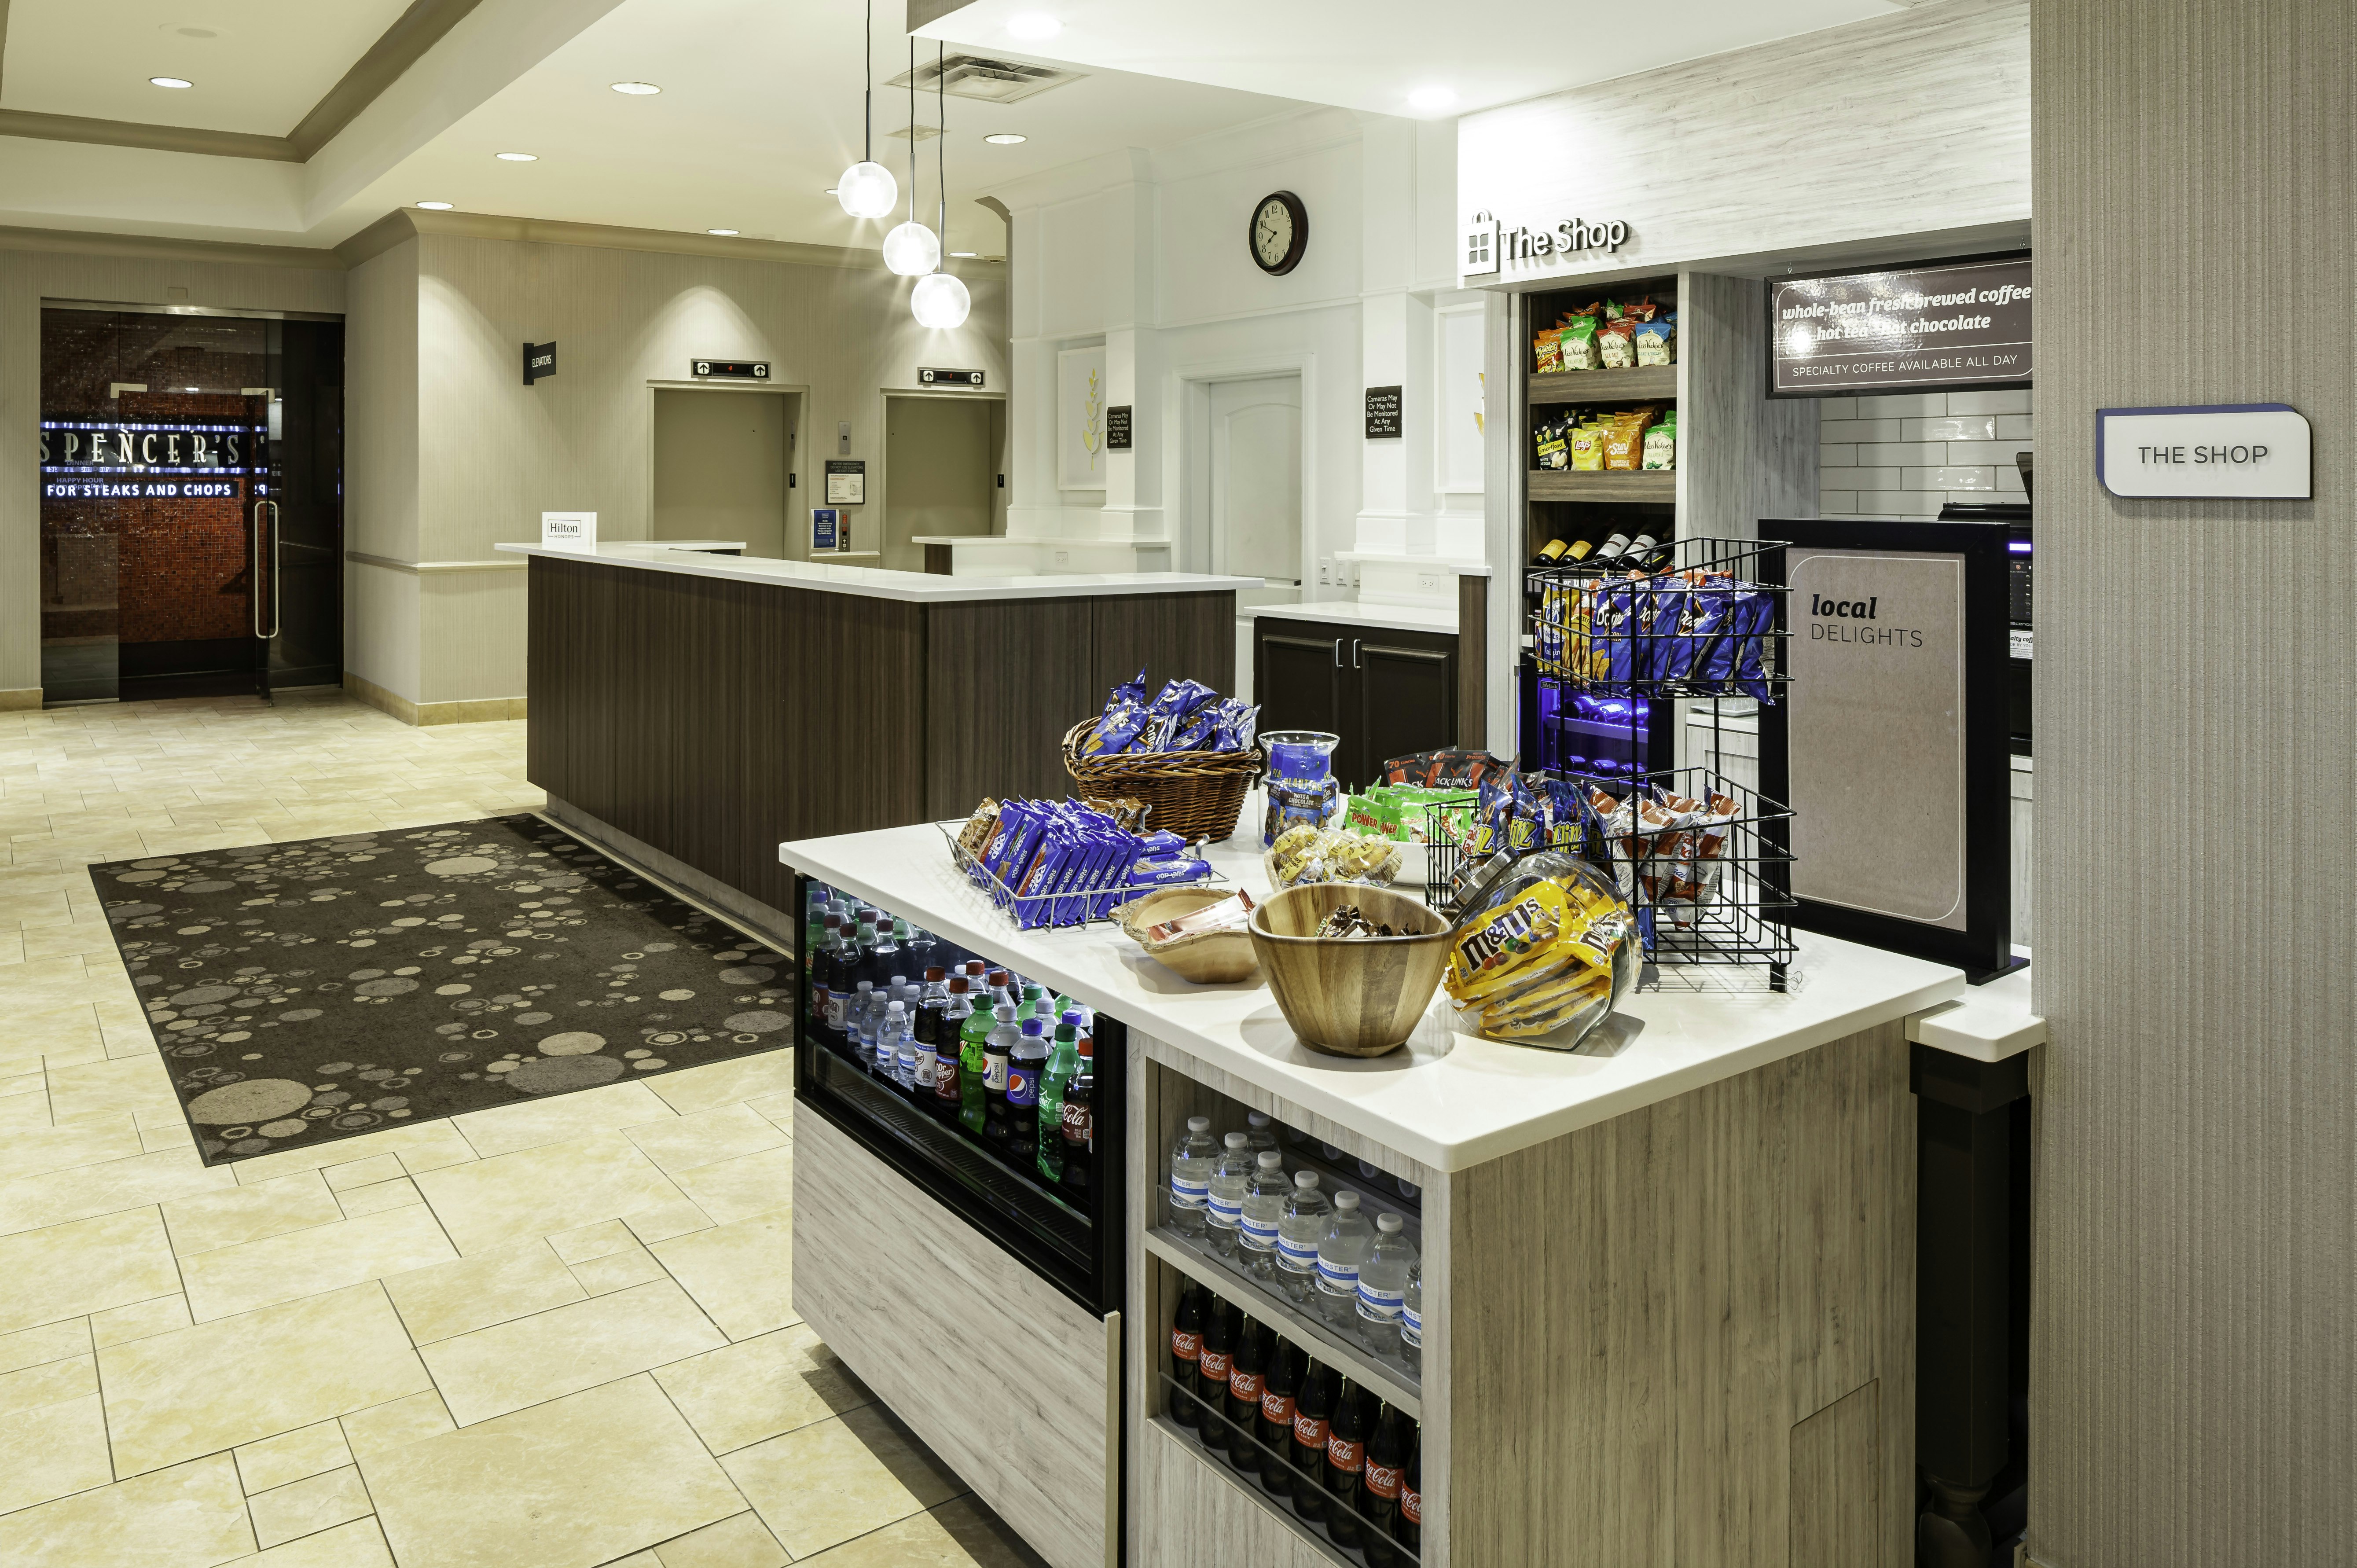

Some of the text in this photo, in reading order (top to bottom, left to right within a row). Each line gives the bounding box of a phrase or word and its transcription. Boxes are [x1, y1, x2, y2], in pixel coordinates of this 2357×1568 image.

[1265, 209, 1269, 218] 11
[1272, 204, 1278, 214] 12
[1281, 206, 1283, 215] 1
[1260, 220, 1266, 229] 10
[1258, 232, 1263, 242] 9
[1499, 218, 1629, 260] The Shop
[1262, 244, 1267, 253] 8
[1268, 251, 1272, 260] 7
[1274, 252, 1279, 262] 6
[1782, 300, 1866, 320] whole-bean
[1979, 284, 2032, 306] coffee
[1910, 314, 1991, 334] chocolate
[532, 354, 551, 367] ELEVATORS
[1793, 354, 2018, 377] SPECIALTY COFFEE AVAILABLE ALL DAY
[40, 431, 239, 464] SPENCER'S
[1538, 442, 1563, 454] Smartfood
[2138, 445, 2268, 464] THE SHOP
[47, 485, 231, 496] FOR STEAKS AND CHOPS
[551, 522, 578, 533] Hilton
[1811, 593, 1878, 620] local
[1811, 624, 1923, 648] DELIGHTS
[1433, 778, 1473, 787] JACK LINK'S
[1289, 797, 1314, 806] CHOCOLATE
[1351, 812, 1378, 829] POWER
